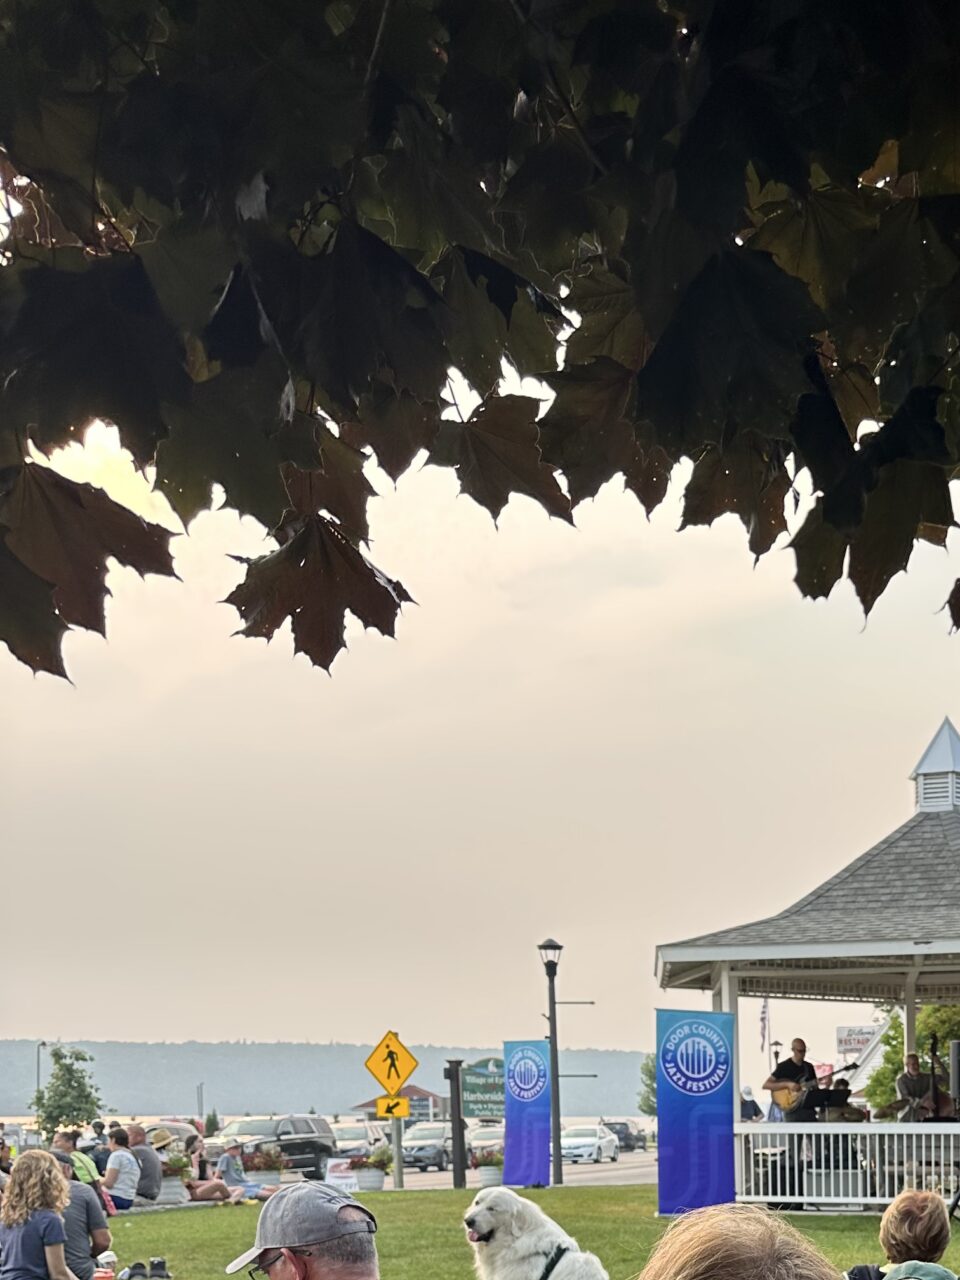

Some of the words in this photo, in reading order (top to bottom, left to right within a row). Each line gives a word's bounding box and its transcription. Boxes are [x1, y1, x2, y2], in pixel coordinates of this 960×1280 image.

[666, 1025, 691, 1050] DOOR
[692, 1024, 727, 1053] COUNTY
[509, 1051, 523, 1069] DOOR
[523, 1049, 545, 1069] COUNTY
[508, 1078, 520, 1096] JAZZ
[520, 1078, 545, 1099] FESTIVAL
[665, 1062, 686, 1087] JAZZ
[686, 1064, 727, 1091] FESTIVAL
